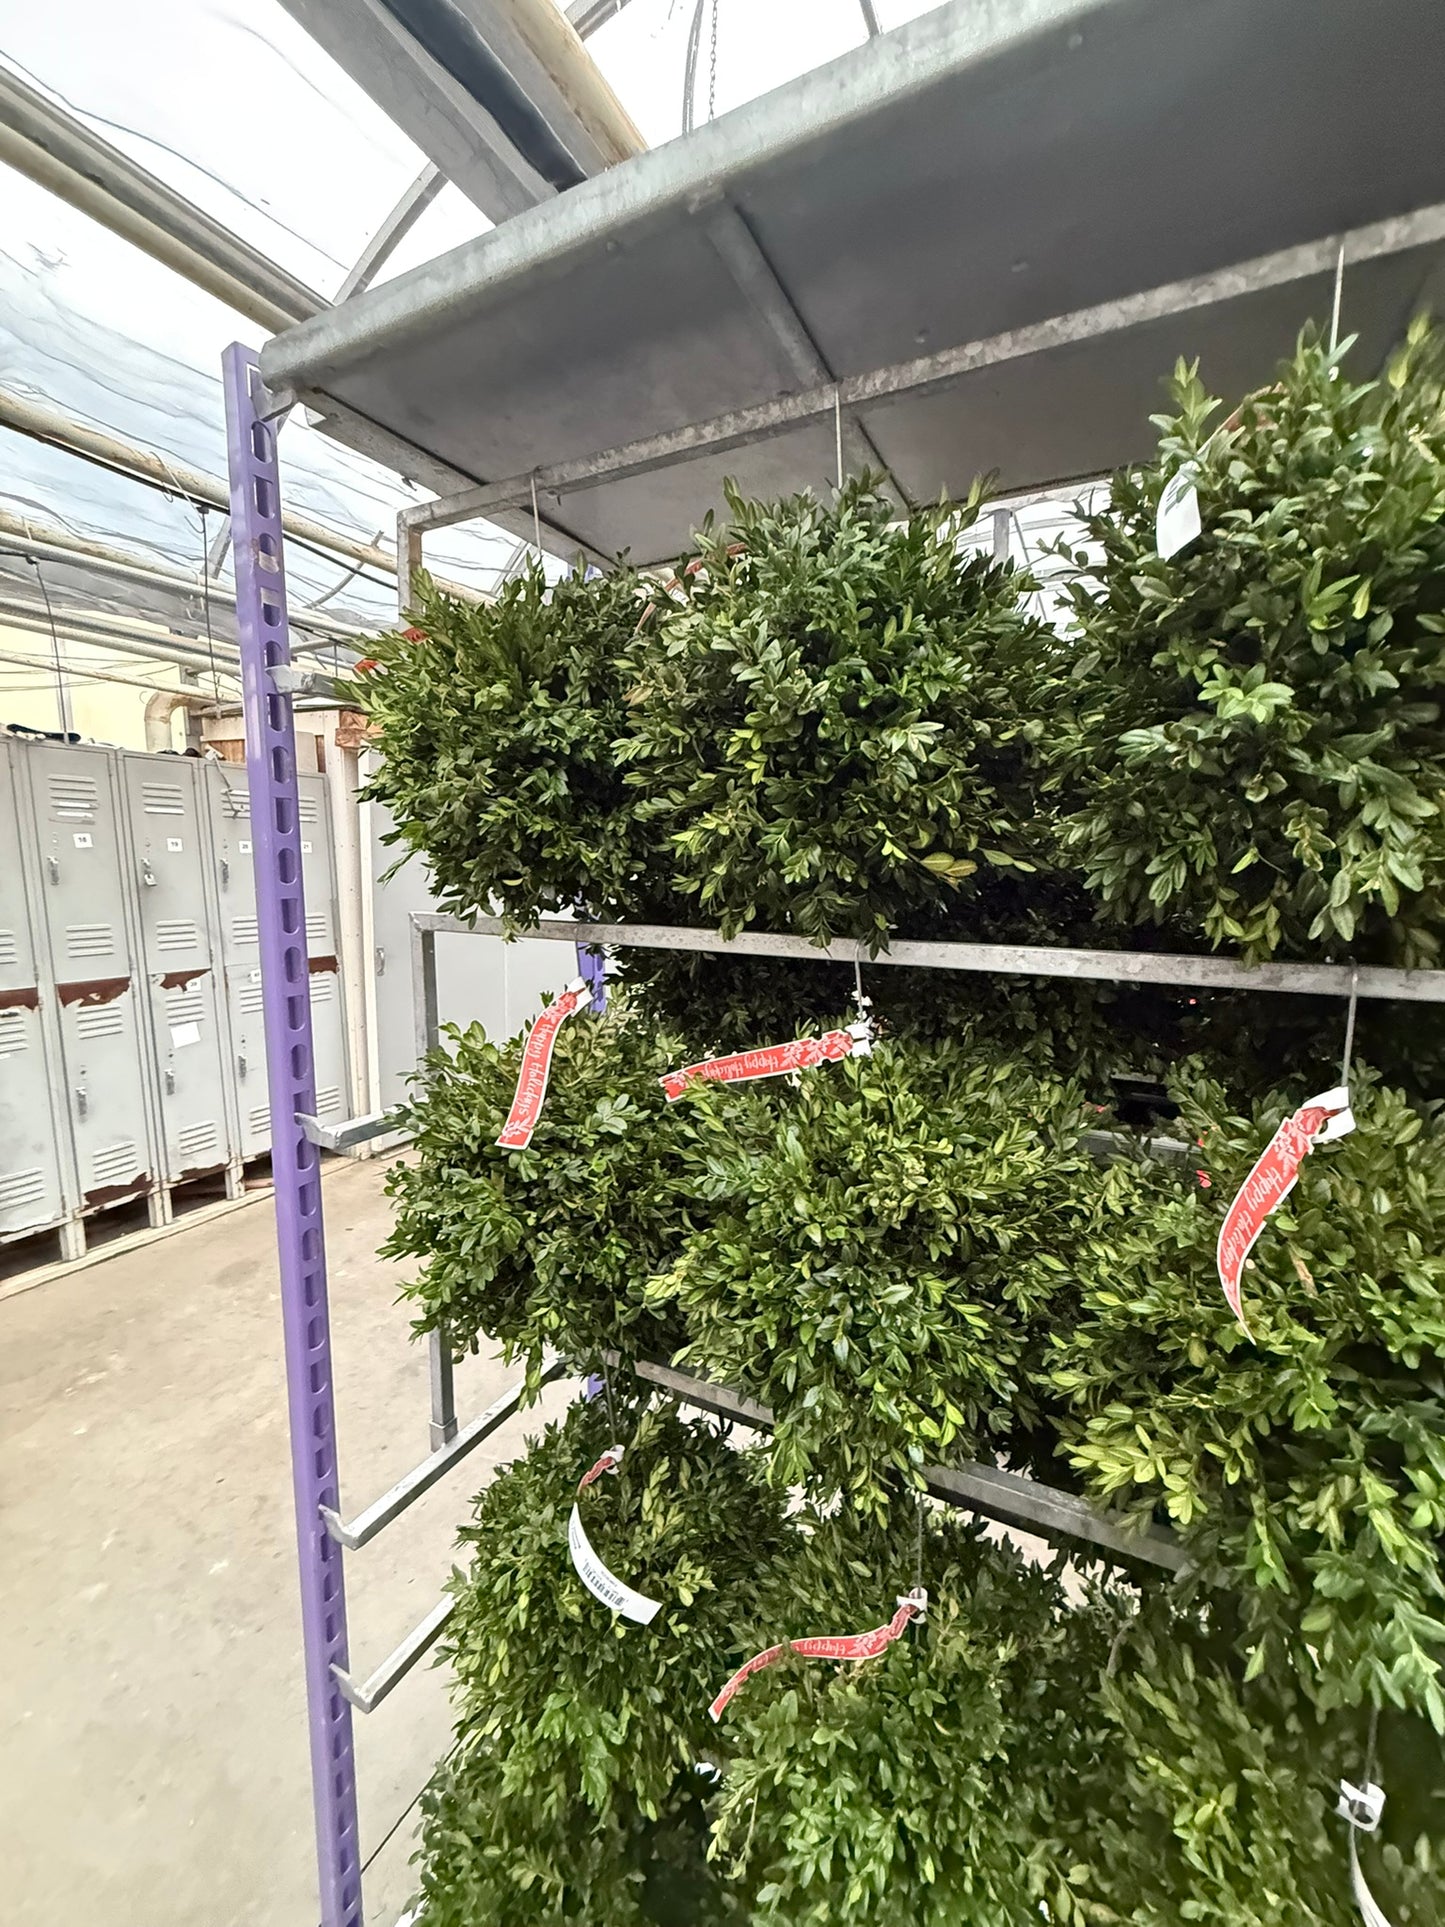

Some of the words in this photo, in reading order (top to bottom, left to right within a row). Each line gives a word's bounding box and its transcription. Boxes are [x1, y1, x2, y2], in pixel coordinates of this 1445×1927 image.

[528, 1023, 554, 1060] Happy
[744, 1053, 779, 1073] Happy
[515, 1062, 545, 1116] Holidays
[1244, 1166, 1283, 1211] Happy
[803, 1639, 847, 1656] Happy
